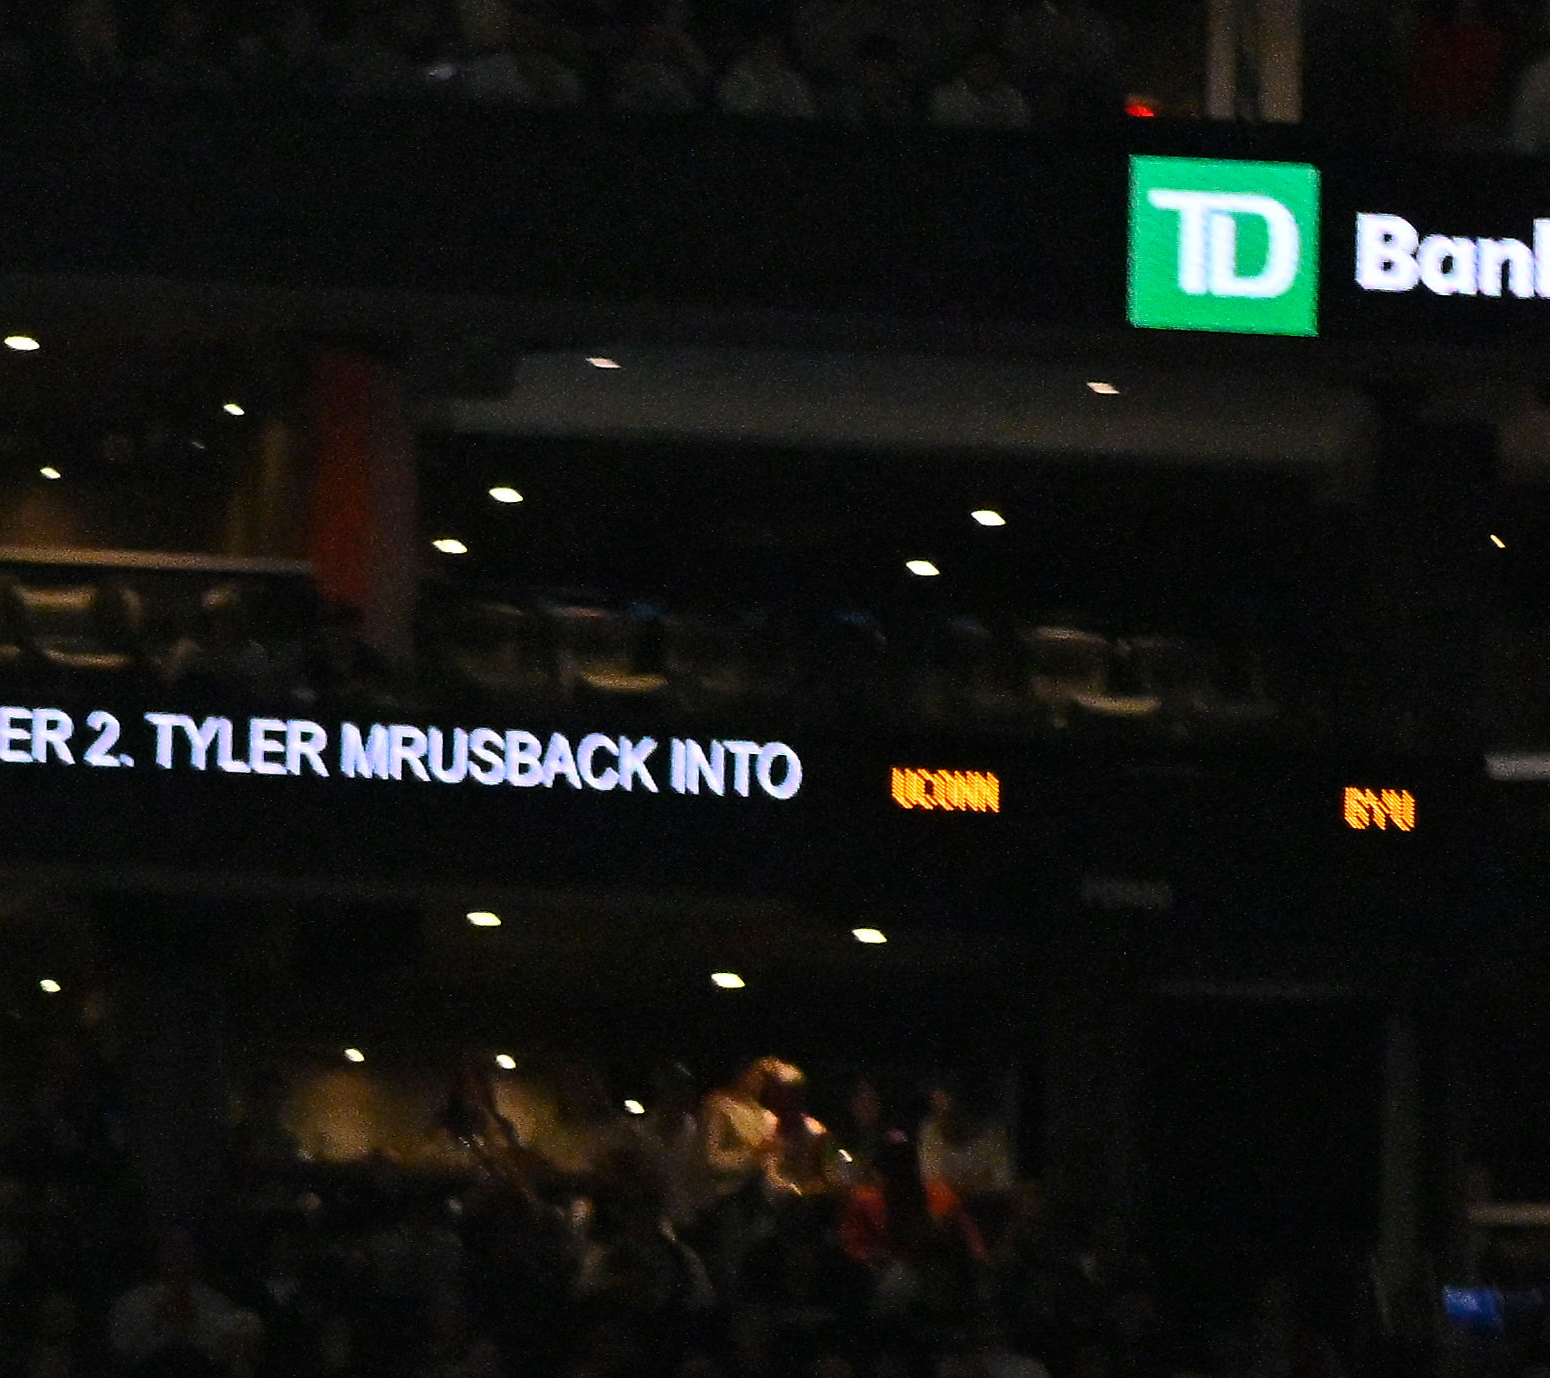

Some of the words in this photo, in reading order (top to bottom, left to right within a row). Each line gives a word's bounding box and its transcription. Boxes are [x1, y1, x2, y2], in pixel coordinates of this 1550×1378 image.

[1148, 189, 1300, 298] TD
[84, 710, 136, 767] 2.
[145, 713, 330, 777] TYLER
[340, 722, 660, 794] MRUSBACK
[670, 738, 803, 800] INTO
[890, 766, 1002, 815] UCONN
